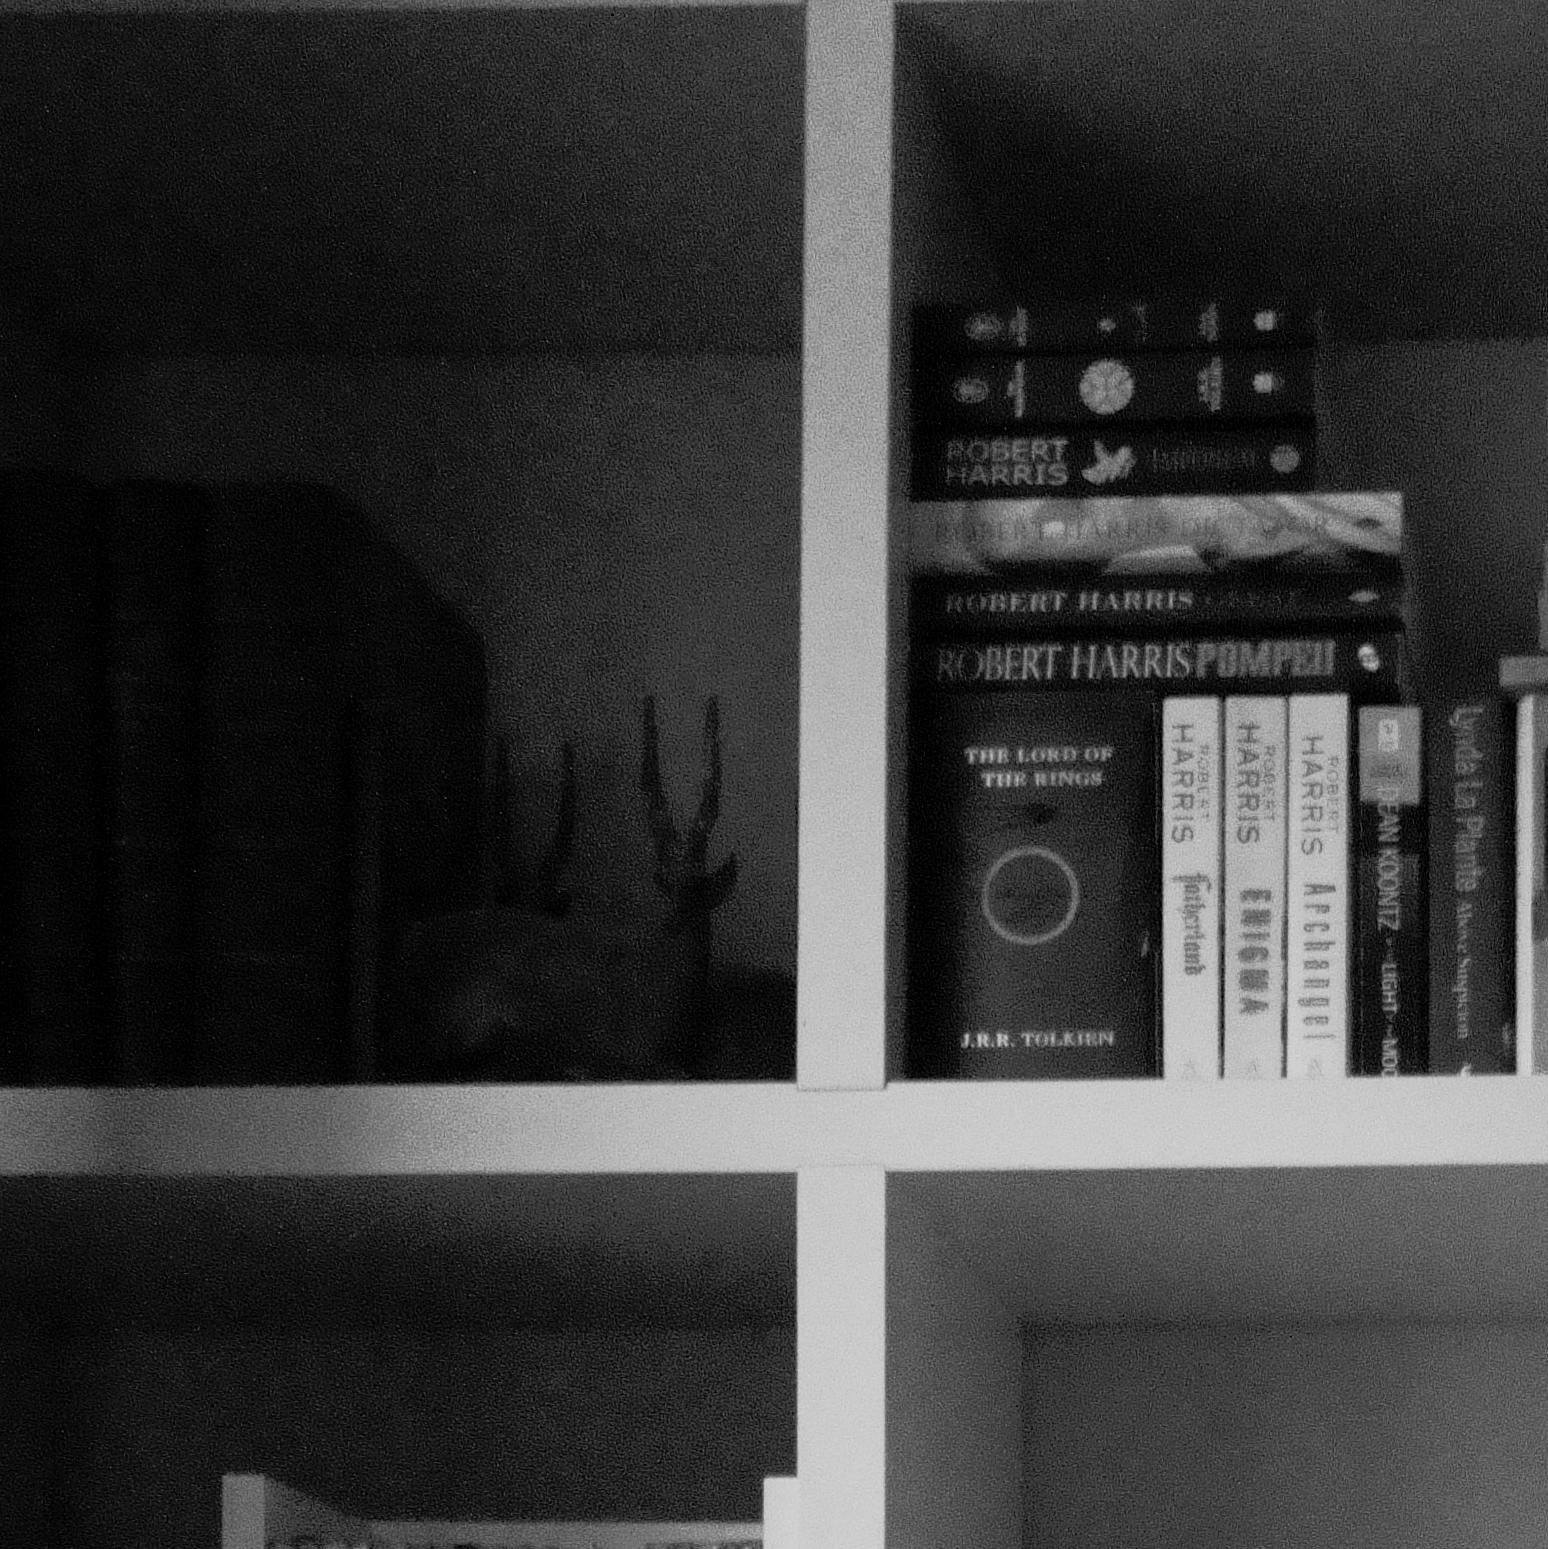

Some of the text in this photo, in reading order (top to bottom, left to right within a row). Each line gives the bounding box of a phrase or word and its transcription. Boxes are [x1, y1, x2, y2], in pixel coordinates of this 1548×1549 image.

[944, 463, 1070, 487] HARRIS
[947, 436, 1069, 463] ROBERT
[945, 590, 1197, 614] ROBERT HARRIS
[937, 644, 1067, 683] ROBERT
[1070, 644, 1193, 681] HARRIS
[965, 743, 1117, 766] THE LORD OF
[980, 768, 1104, 788] THE RINGS
[1170, 722, 1197, 845] HARRIS
[1236, 721, 1261, 846] HARRIS
[1261, 744, 1278, 823] ROBERT
[1300, 734, 1325, 857] HARRIS
[1448, 705, 1486, 893] Lynda La Plante
[1376, 782, 1403, 1015] DEAN KOONTZ LIGHT
[1237, 888, 1273, 1018] ENIGMA
[1297, 881, 1338, 1042] Archangel
[960, 1027, 1117, 1050] J.R.R. TOLKIEN
